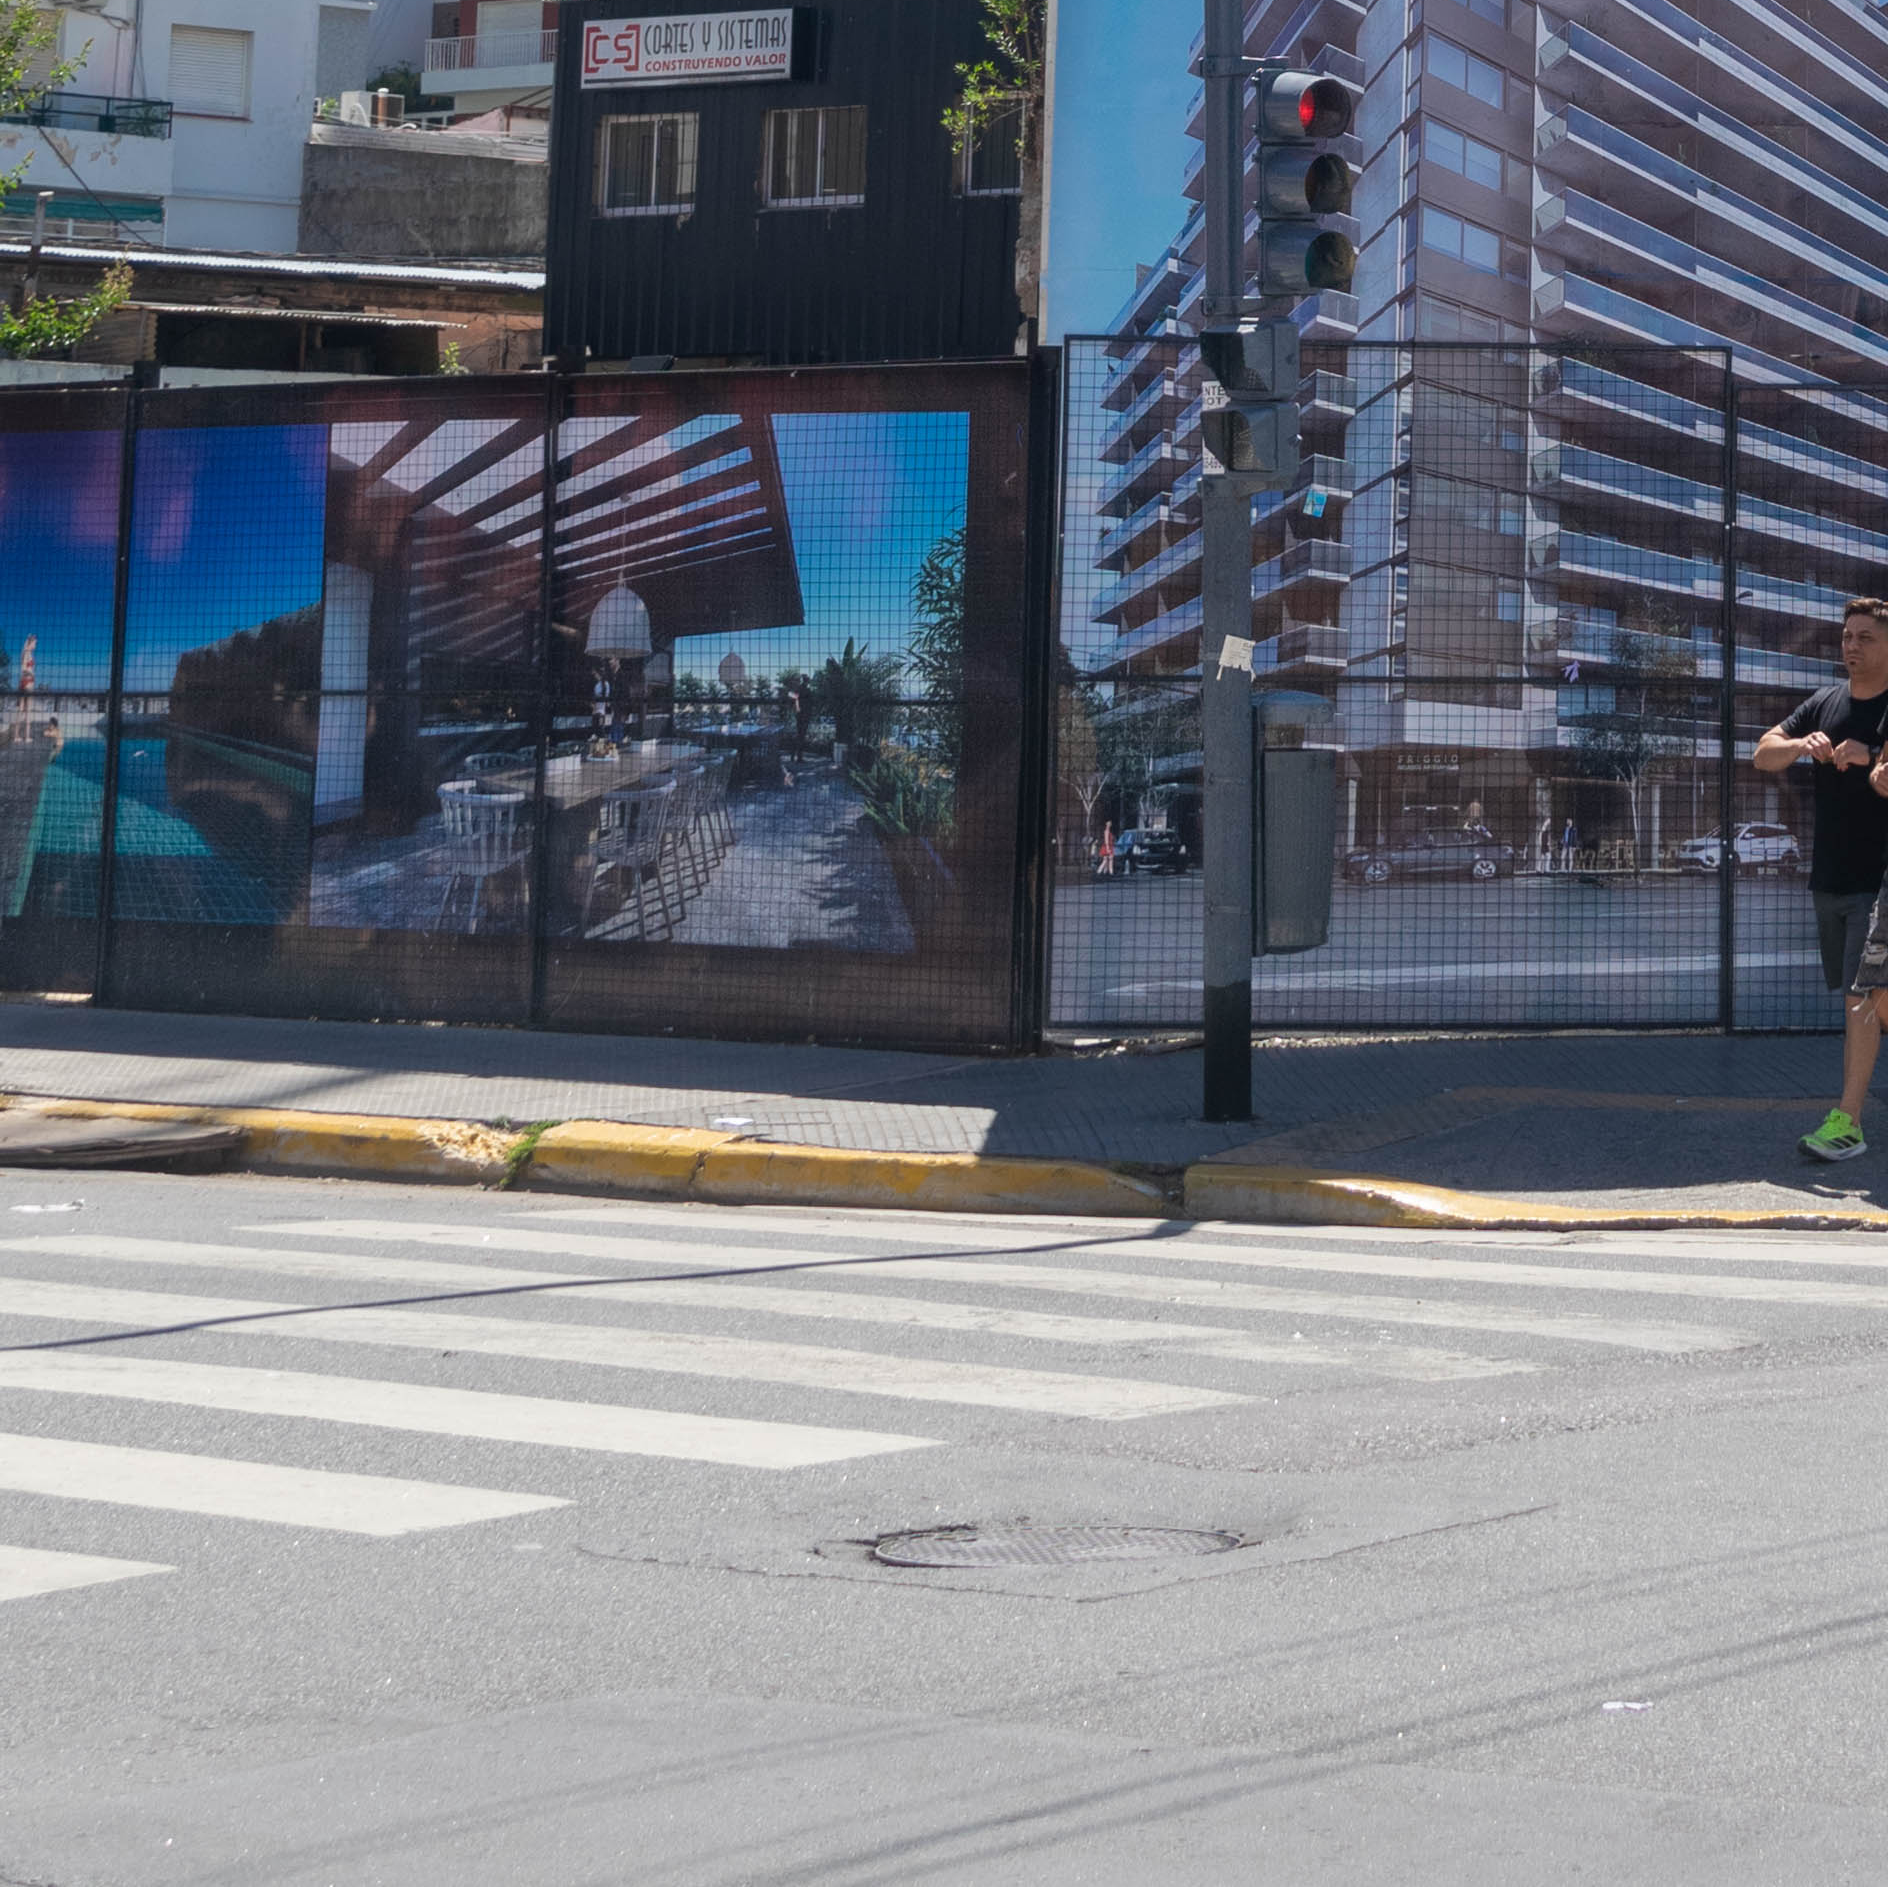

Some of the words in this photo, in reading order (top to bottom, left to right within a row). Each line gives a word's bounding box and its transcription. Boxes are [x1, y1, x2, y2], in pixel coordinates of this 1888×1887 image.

[644, 23, 694, 56] CORTES
[702, 21, 711, 52] Y
[718, 16, 787, 51] SISTEMAS
[645, 56, 741, 73] CONSTRUYENDO
[745, 53, 786, 66] VALOR
